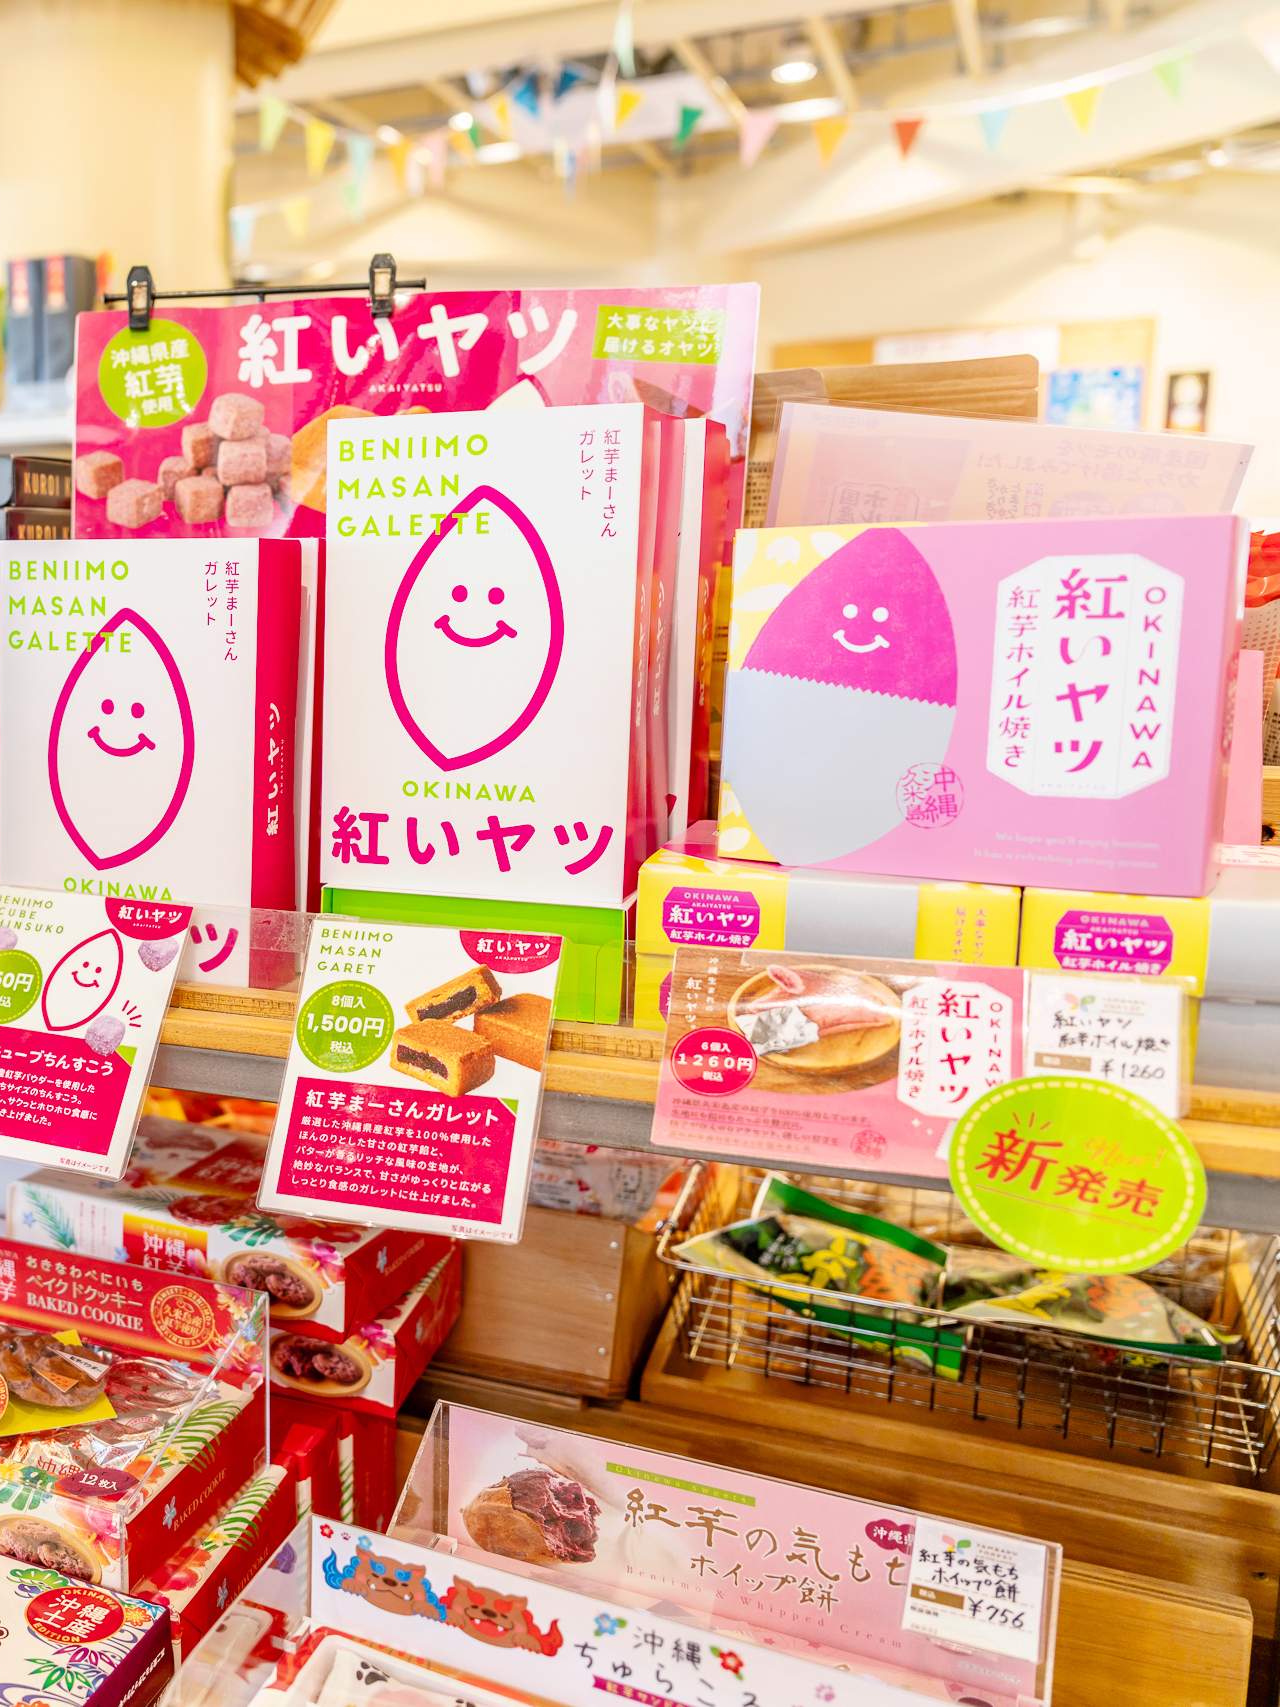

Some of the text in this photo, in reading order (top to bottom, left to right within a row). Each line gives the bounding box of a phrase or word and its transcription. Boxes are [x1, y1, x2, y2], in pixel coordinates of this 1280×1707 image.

[111, 338, 190, 369] 沖縄県産
[238, 304, 578, 388] 紅いヤツ
[124, 363, 184, 399] 紅芋
[369, 383, 442, 393] AKAIYATSU
[141, 396, 173, 416] 使用
[339, 434, 489, 462] BENIIMO
[579, 430, 595, 501] ガレット
[24, 471, 61, 496] KUROI
[338, 474, 460, 500] MASAN
[601, 429, 621, 538] 紅芋まーさん
[337, 512, 490, 537] GALETTE
[9, 560, 129, 581] BENIIMO
[8, 596, 106, 617] MASAN
[204, 561, 218, 626] ガレット
[224, 561, 240, 662] 紅芋まーさん
[8, 630, 132, 653] GALETTE
[998, 585, 1040, 767] 紅芋ホイル焼き
[1053, 567, 1128, 773] 紅いヤツ
[1130, 587, 1166, 769] OKINAWA
[266, 702, 280, 836] 紅いヤツ
[402, 780, 536, 803] OKINAWA
[331, 806, 614, 876] 紅いヤツ
[64, 877, 172, 900] OKINAWA
[684, 891, 739, 903] OKINAWA
[118, 905, 182, 924] 紅いヤツ
[668, 905, 754, 928] 紅いヤツ
[1080, 914, 1150, 928] OKINAWA
[321, 928, 393, 942] BENIIMO
[477, 938, 551, 956] 紅いヤツ
[670, 929, 751, 946] 紅芋ホイル焼き
[1060, 928, 1167, 955] 紅いヤツ
[320, 945, 382, 958] MASAN
[317, 961, 376, 975] GARET
[1061, 956, 1161, 975] 紅芋ホイル焼き
[331, 994, 366, 1010] 8個入
[307, 1013, 384, 1038] 1,500円
[1052, 1010, 1132, 1029] 紅いヤツ
[330, 1041, 353, 1054] 税込
[937, 988, 980, 1103] 紅いヤツ
[703, 1071, 723, 1082] 税込
[305, 1090, 499, 1127] 紅芋まーさんガレット
[299, 1131, 444, 1157] ほんのりとした甘さの紅芋餡と、
[301, 1116, 492, 1147] 厳選した沖縄県産紅芋を100%使用した
[296, 1146, 464, 1175] バターが香るリッチな風味の生地が、
[975, 1129, 1164, 1219] 新発売
[291, 1175, 477, 1208] しっとり食感のガレットに仕上げました。
[143, 1232, 186, 1259] 沖縄
[27, 1255, 144, 1292] おきなわべにいも
[26, 1275, 144, 1308] ベイクドクッキー
[27, 1292, 144, 1331] BAKED COOKIE
[163, 1304, 203, 1327] 久米島産
[163, 1320, 200, 1340] 紅芋使用
[78, 1472, 118, 1491] 12枚入
[615, 1464, 748, 1505] Okinawa sweets
[173, 1467, 227, 1532] BAKED COOKIE
[918, 1549, 1019, 1580] 紅芋の気もち
[689, 1553, 839, 1614] ホイップ餅
[932, 1567, 1020, 1602] ホイップ餅
[49, 1595, 111, 1625] 沖縄
[62, 1588, 119, 1611] OKINAWA
[626, 1564, 704, 1594] Beniimo
[739, 1595, 827, 1628] Whipped
[839, 1623, 903, 1650] Cream
[968, 1596, 1026, 1629] ¥756
[32, 1621, 81, 1643] EDITION
[34, 1610, 96, 1639] 土産
[633, 1626, 703, 1672] 沖縄
